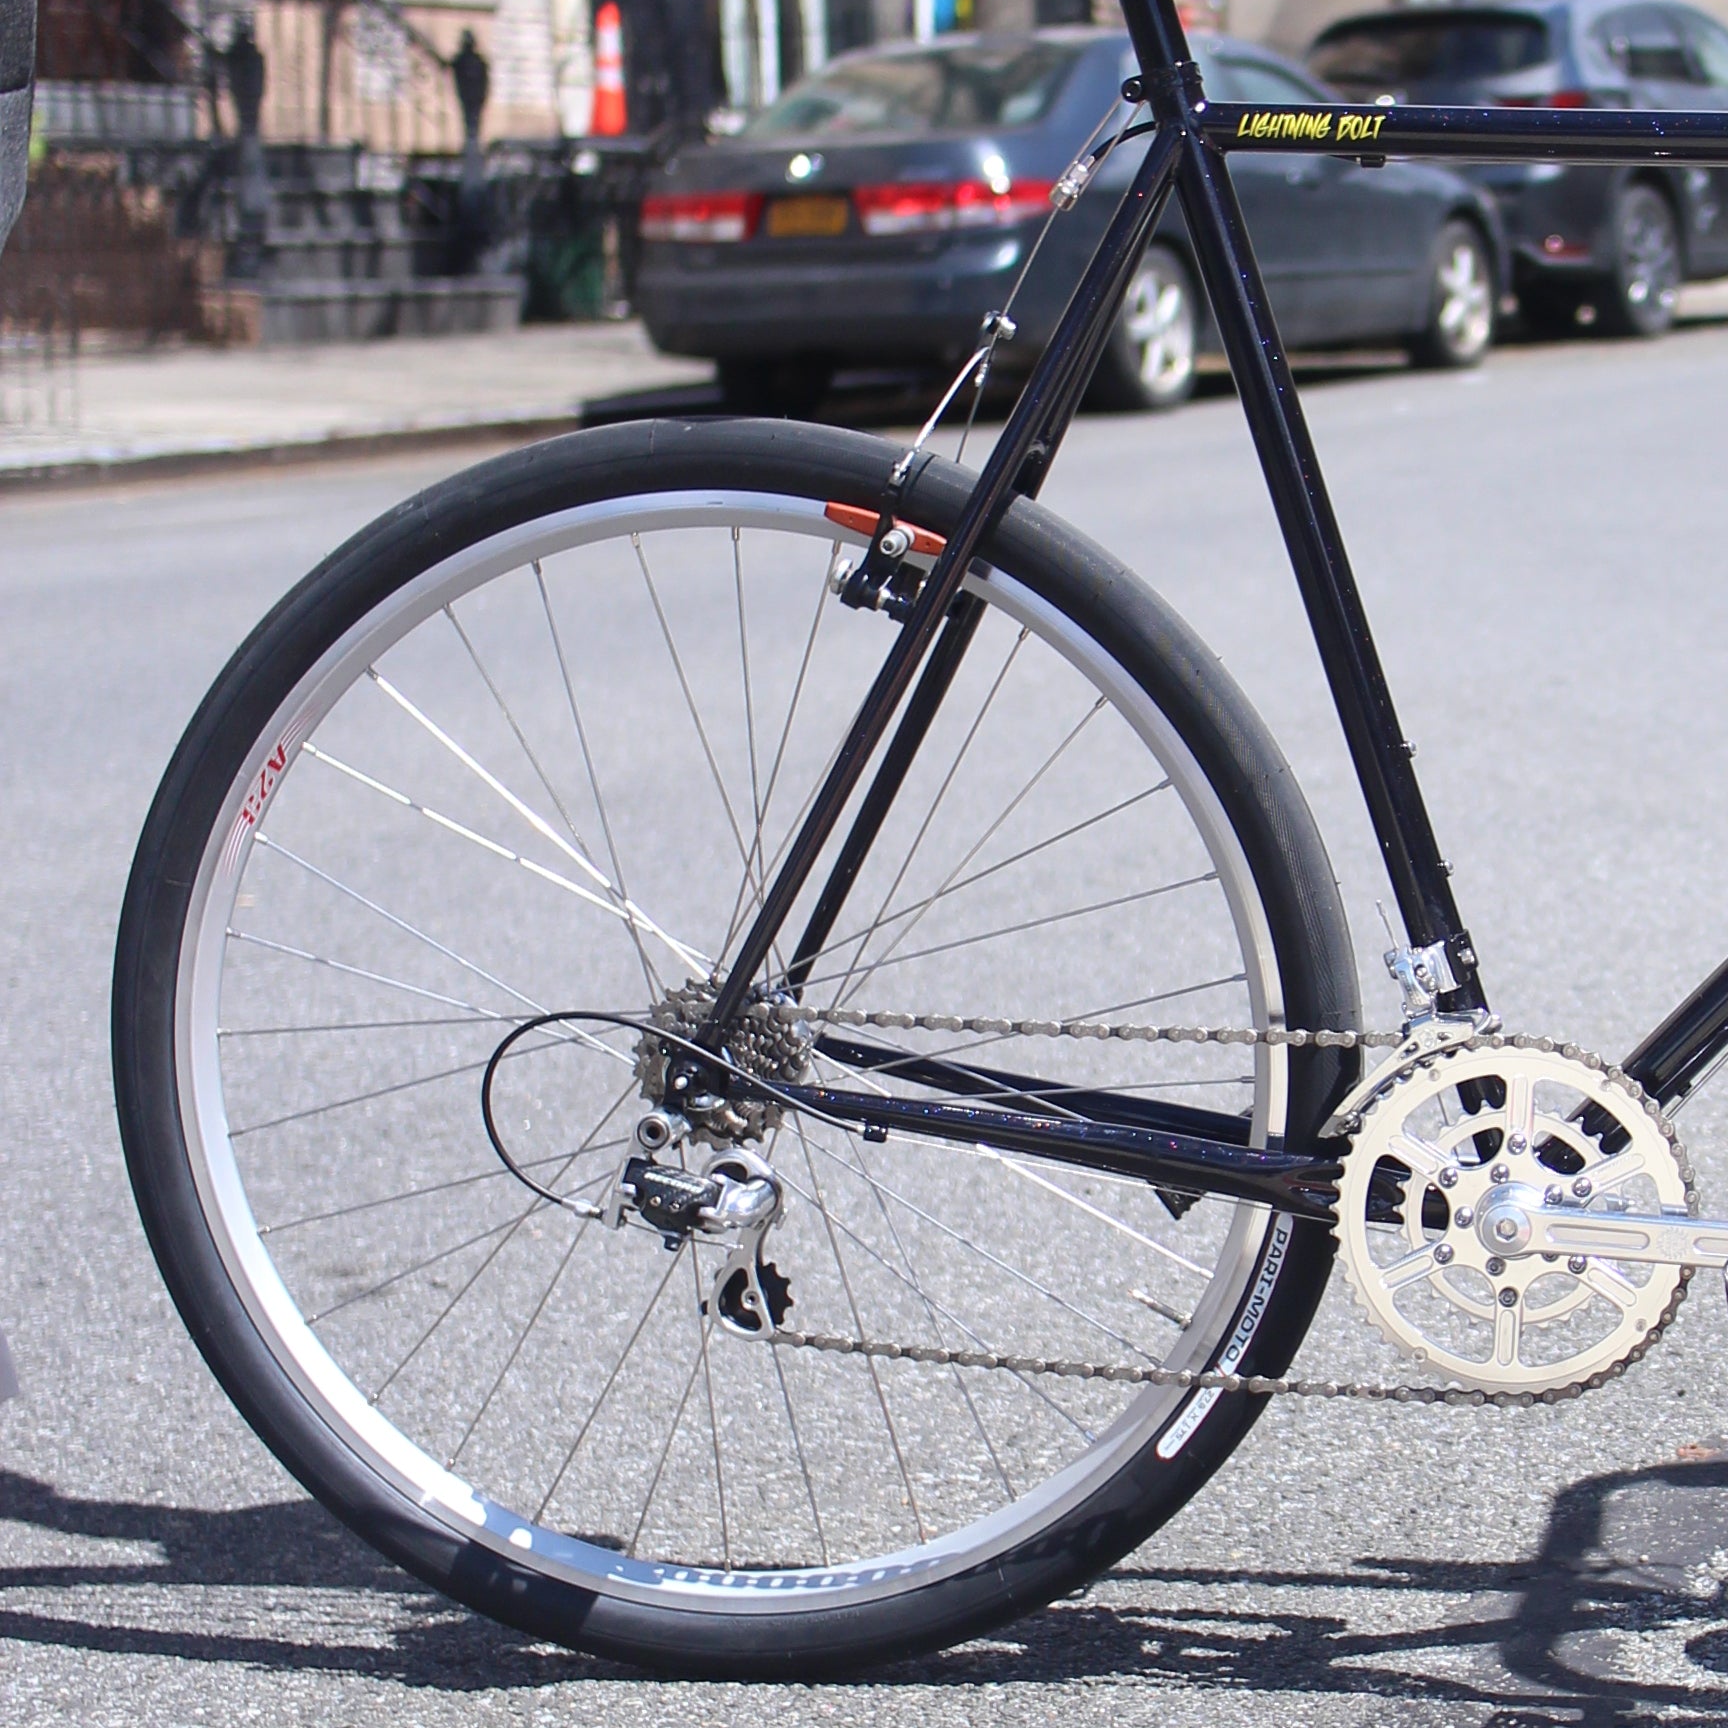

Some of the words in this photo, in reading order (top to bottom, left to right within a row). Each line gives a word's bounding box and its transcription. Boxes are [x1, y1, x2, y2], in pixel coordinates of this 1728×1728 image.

[1237, 112, 1333, 140] LIGHTNING
[1336, 115, 1386, 142] BOLT
[242, 744, 287, 826] A23
[1225, 1227, 1289, 1364] PARI-MOTO
